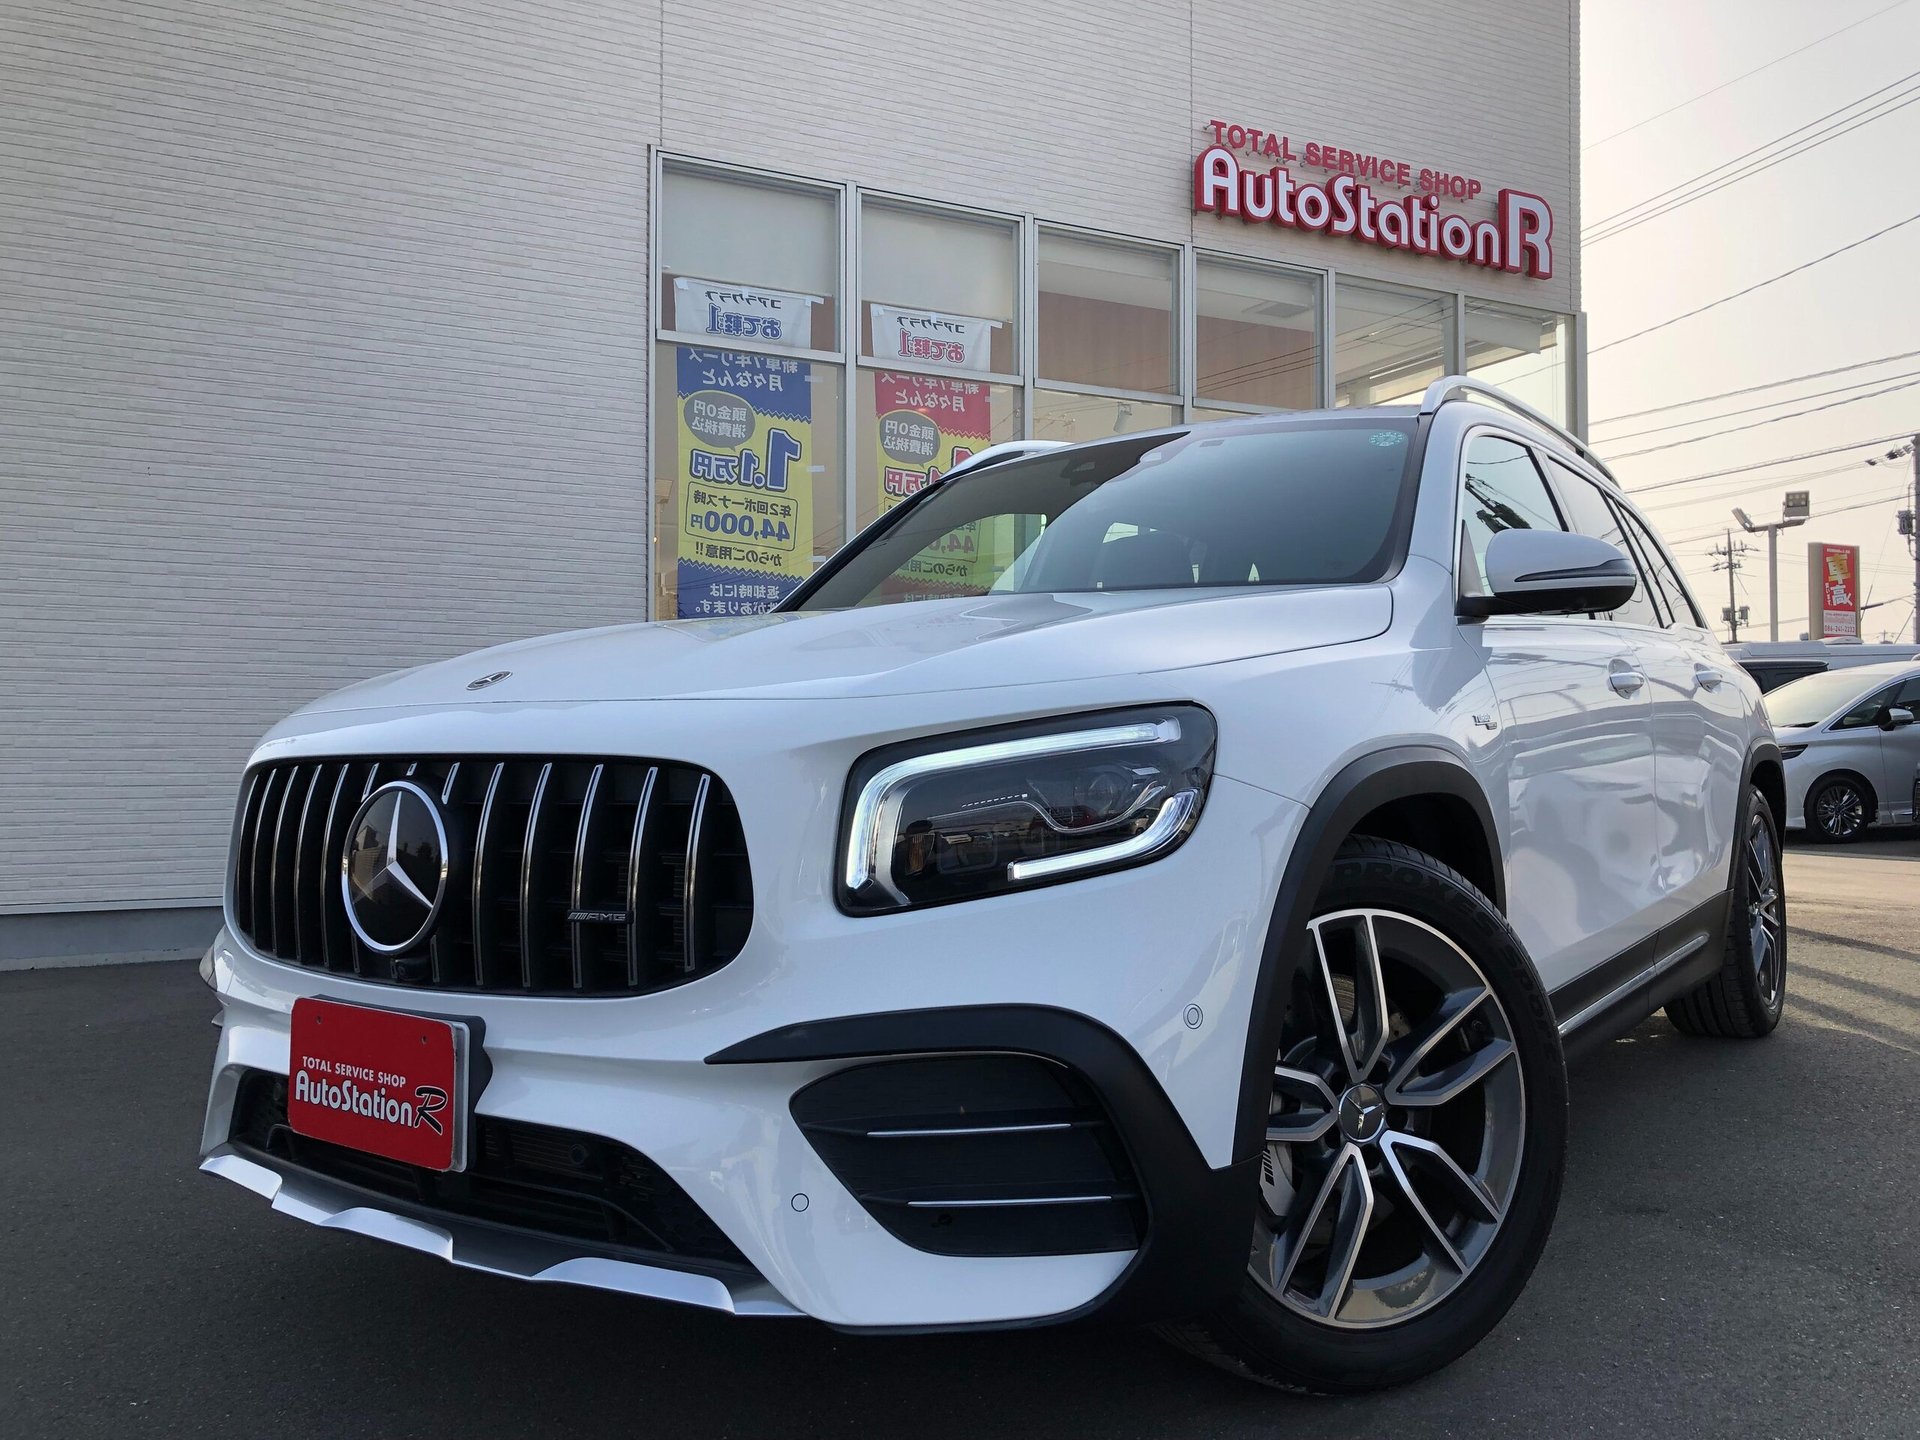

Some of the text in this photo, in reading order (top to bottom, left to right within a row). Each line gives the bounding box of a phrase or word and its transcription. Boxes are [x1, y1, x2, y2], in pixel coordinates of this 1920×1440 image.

[1209, 119, 1482, 200] TOTAL SERVICE SHOP
[302, 1055, 406, 1088] TOTAL SERVICE SHOP
